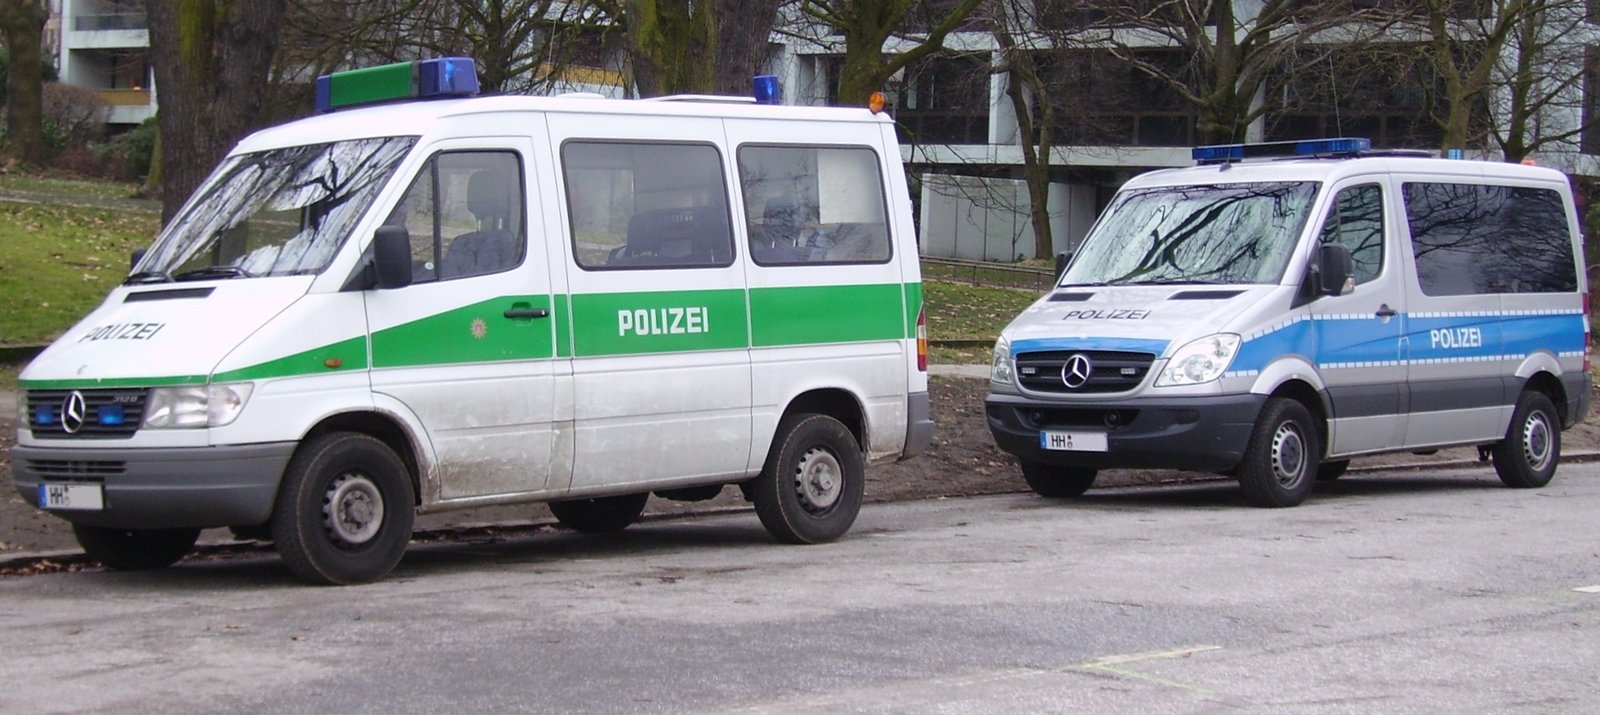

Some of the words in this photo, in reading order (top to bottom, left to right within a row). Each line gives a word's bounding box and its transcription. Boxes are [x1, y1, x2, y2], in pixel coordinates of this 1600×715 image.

[618, 306, 709, 336] POLIZEI
[1062, 309, 1152, 320] POLIZEI
[78, 322, 166, 343] POLIZEI
[1430, 327, 1482, 349] POLIZEI
[1051, 434, 1066, 448] HH
[49, 486, 64, 505] HH
